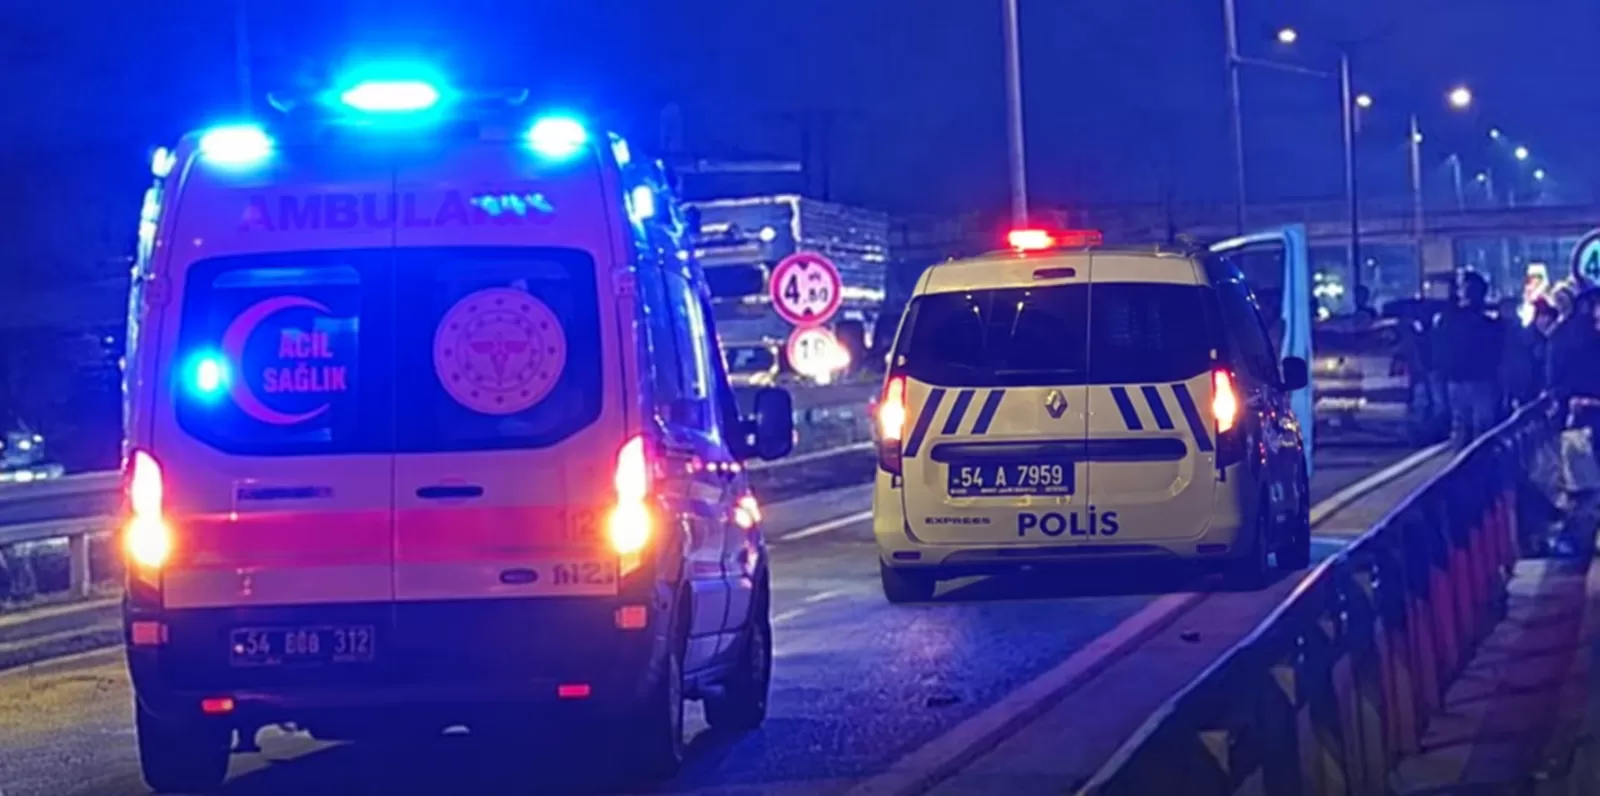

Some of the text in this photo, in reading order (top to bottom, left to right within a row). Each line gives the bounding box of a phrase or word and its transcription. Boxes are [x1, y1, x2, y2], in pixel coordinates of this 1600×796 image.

[262, 361, 348, 393] SAĞLIK
[961, 464, 1063, 487] 54 A 7959
[1017, 504, 1120, 537] POLİS
[333, 627, 369, 654] 312
